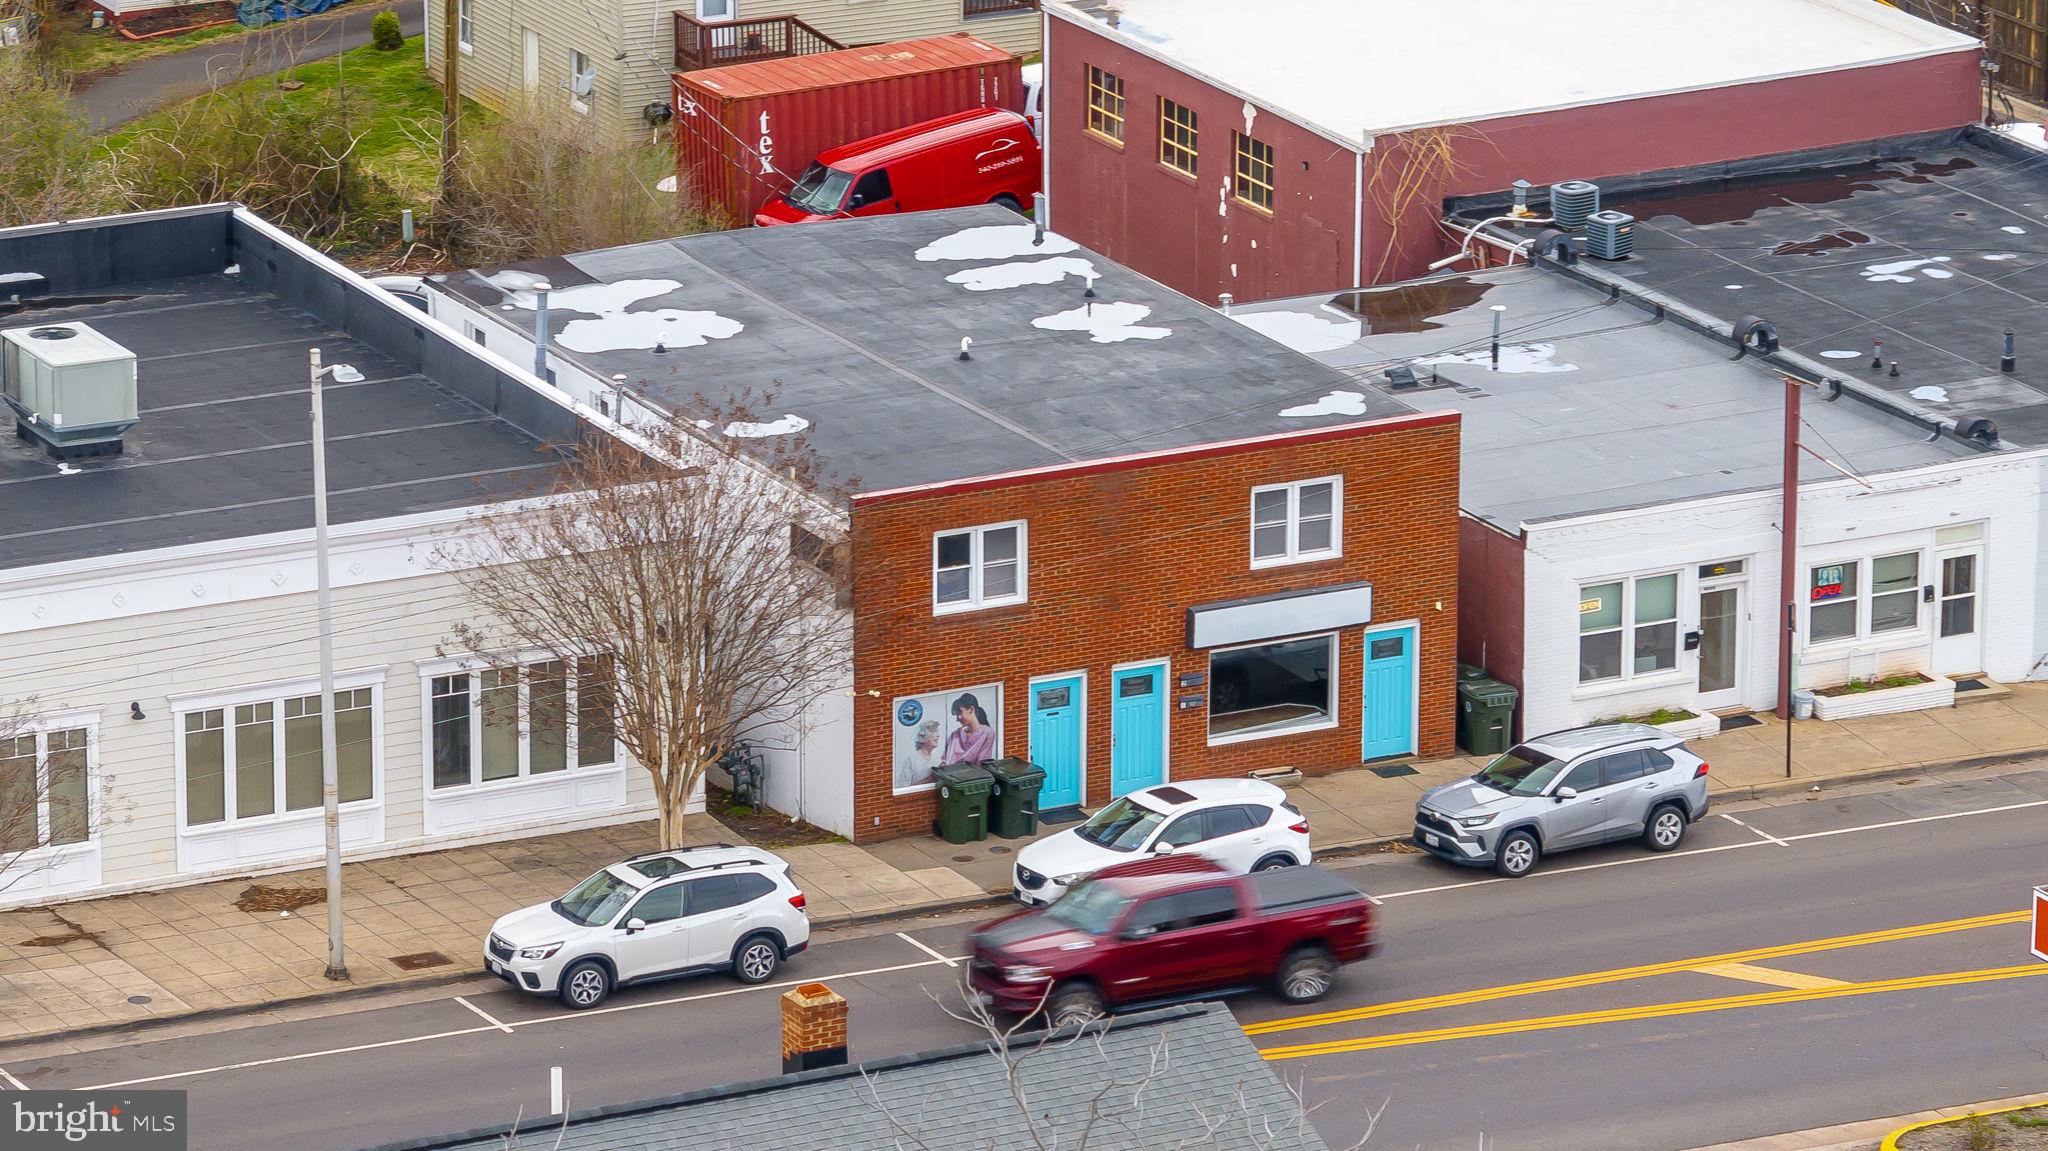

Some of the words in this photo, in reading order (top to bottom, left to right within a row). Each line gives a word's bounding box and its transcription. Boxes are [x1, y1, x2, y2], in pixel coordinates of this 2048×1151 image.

[759, 110, 775, 175] tex
[1811, 584, 1843, 599] OPEN
[1578, 600, 1600, 612] OPEN
